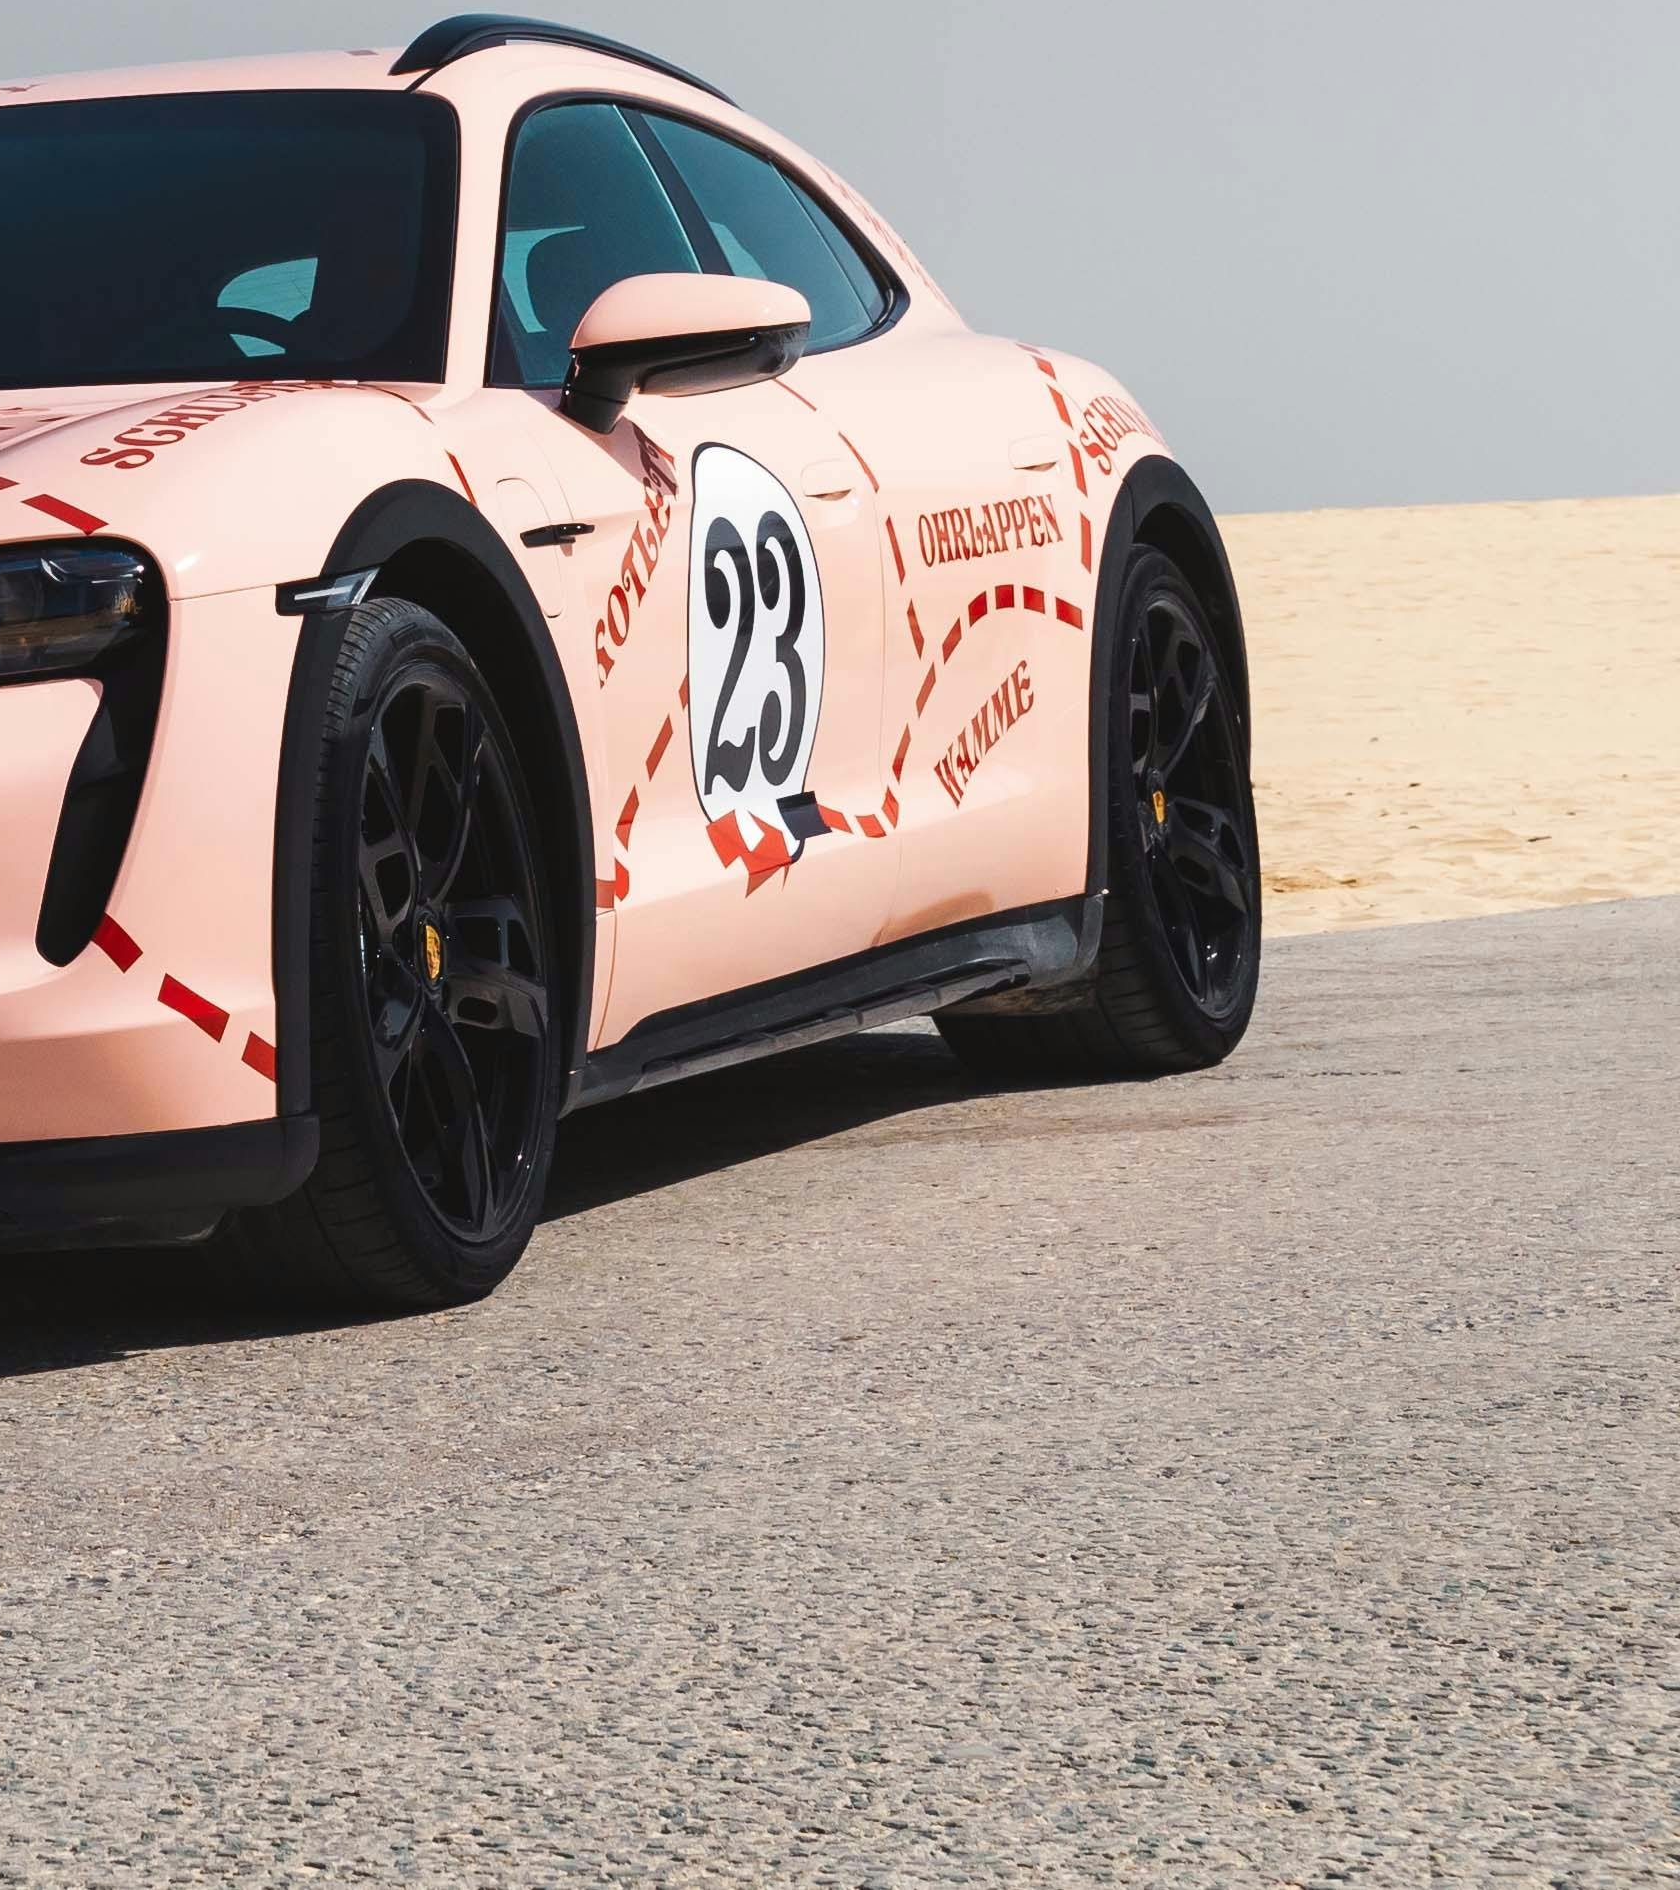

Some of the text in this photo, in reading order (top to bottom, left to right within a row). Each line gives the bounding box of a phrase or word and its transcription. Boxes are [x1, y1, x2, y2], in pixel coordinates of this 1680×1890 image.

[917, 492, 1065, 568] OHRLAPPEN
[703, 510, 807, 797] 23
[933, 658, 1035, 810] WAMME
